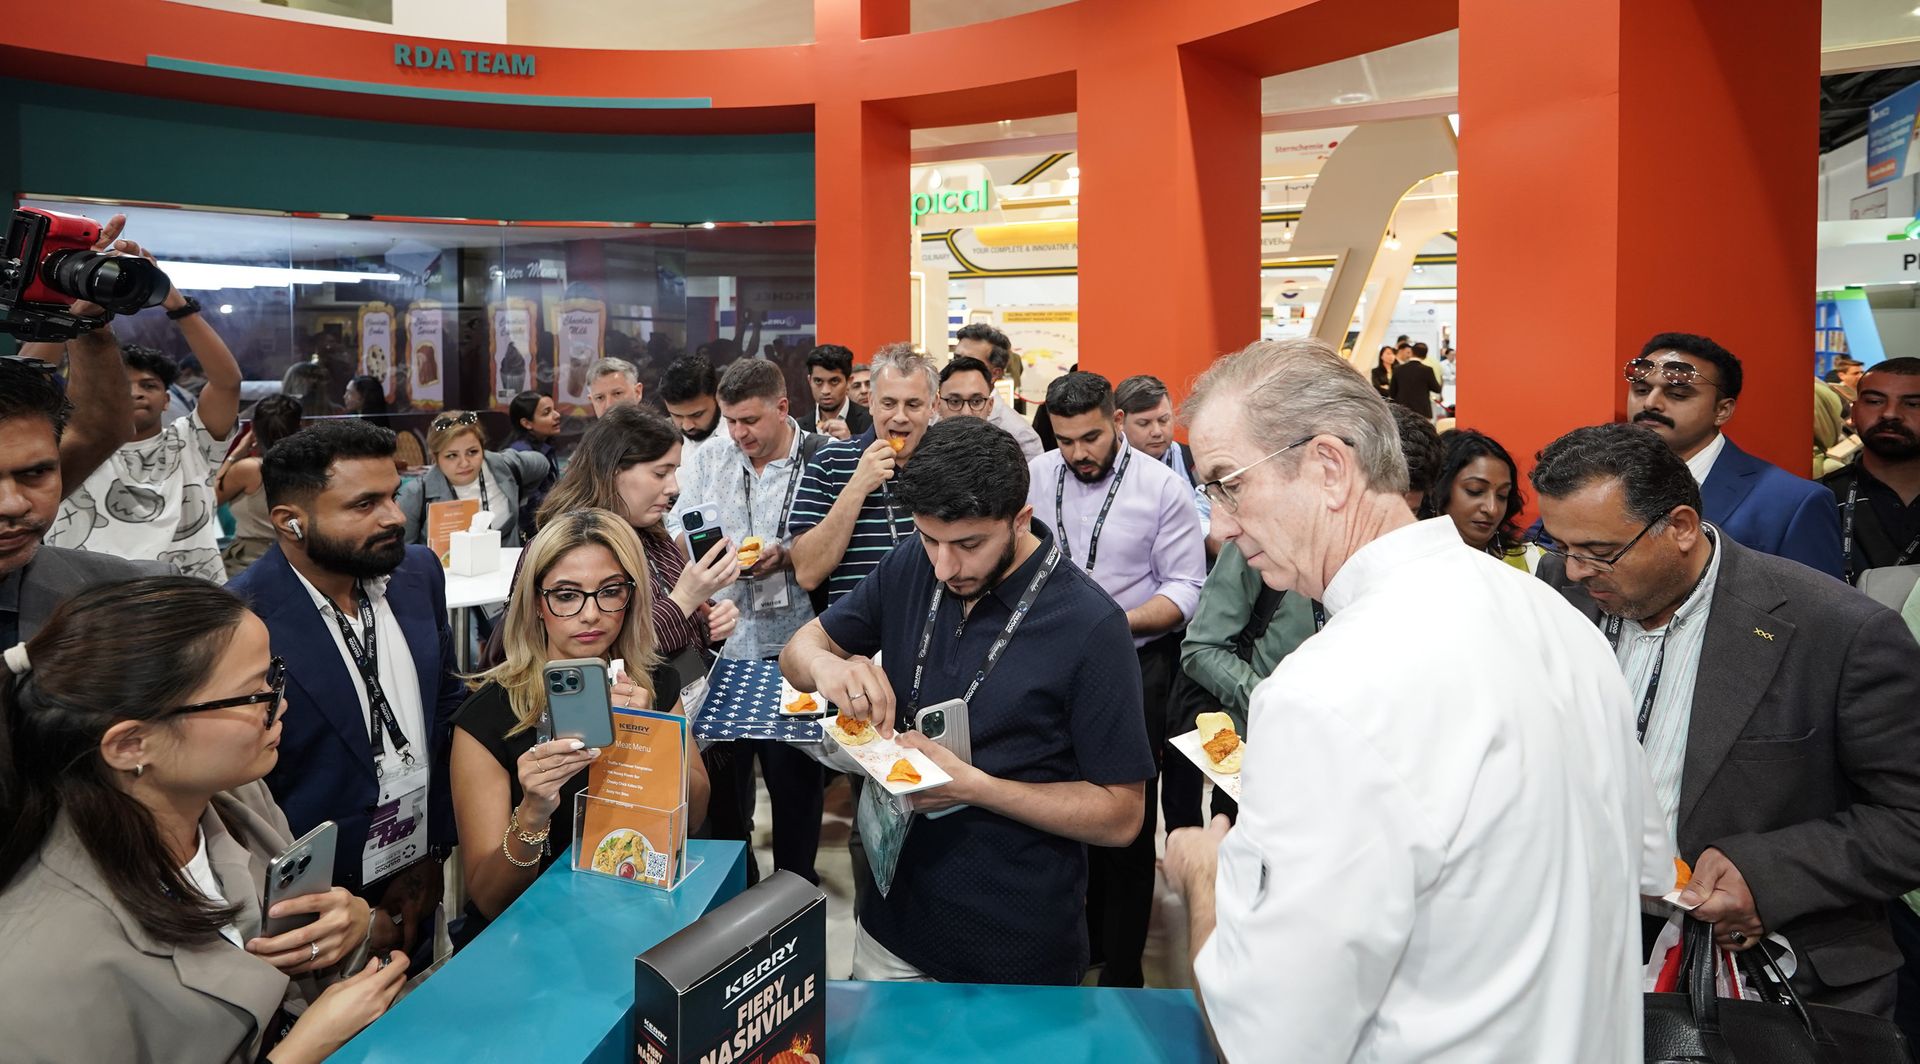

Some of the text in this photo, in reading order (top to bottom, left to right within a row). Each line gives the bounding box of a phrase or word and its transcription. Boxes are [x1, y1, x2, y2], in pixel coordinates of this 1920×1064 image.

[394, 43, 536, 76] RDA TEAM
[911, 179, 989, 226] pical
[990, 245, 1023, 254] COMPLETE
[1031, 243, 1069, 252] INNOVATIVE
[1904, 253, 1920, 271] P
[1007, 611, 1022, 634] GULFOOD
[619, 722, 650, 733] KERRY
[615, 739, 651, 753] Meat Menu
[375, 858, 401, 874] GULFOOD
[725, 936, 798, 1000] KERRY
[737, 974, 785, 1029] FIERY
[644, 1018, 667, 1041] KERRY
[647, 1042, 663, 1063] FIERY
